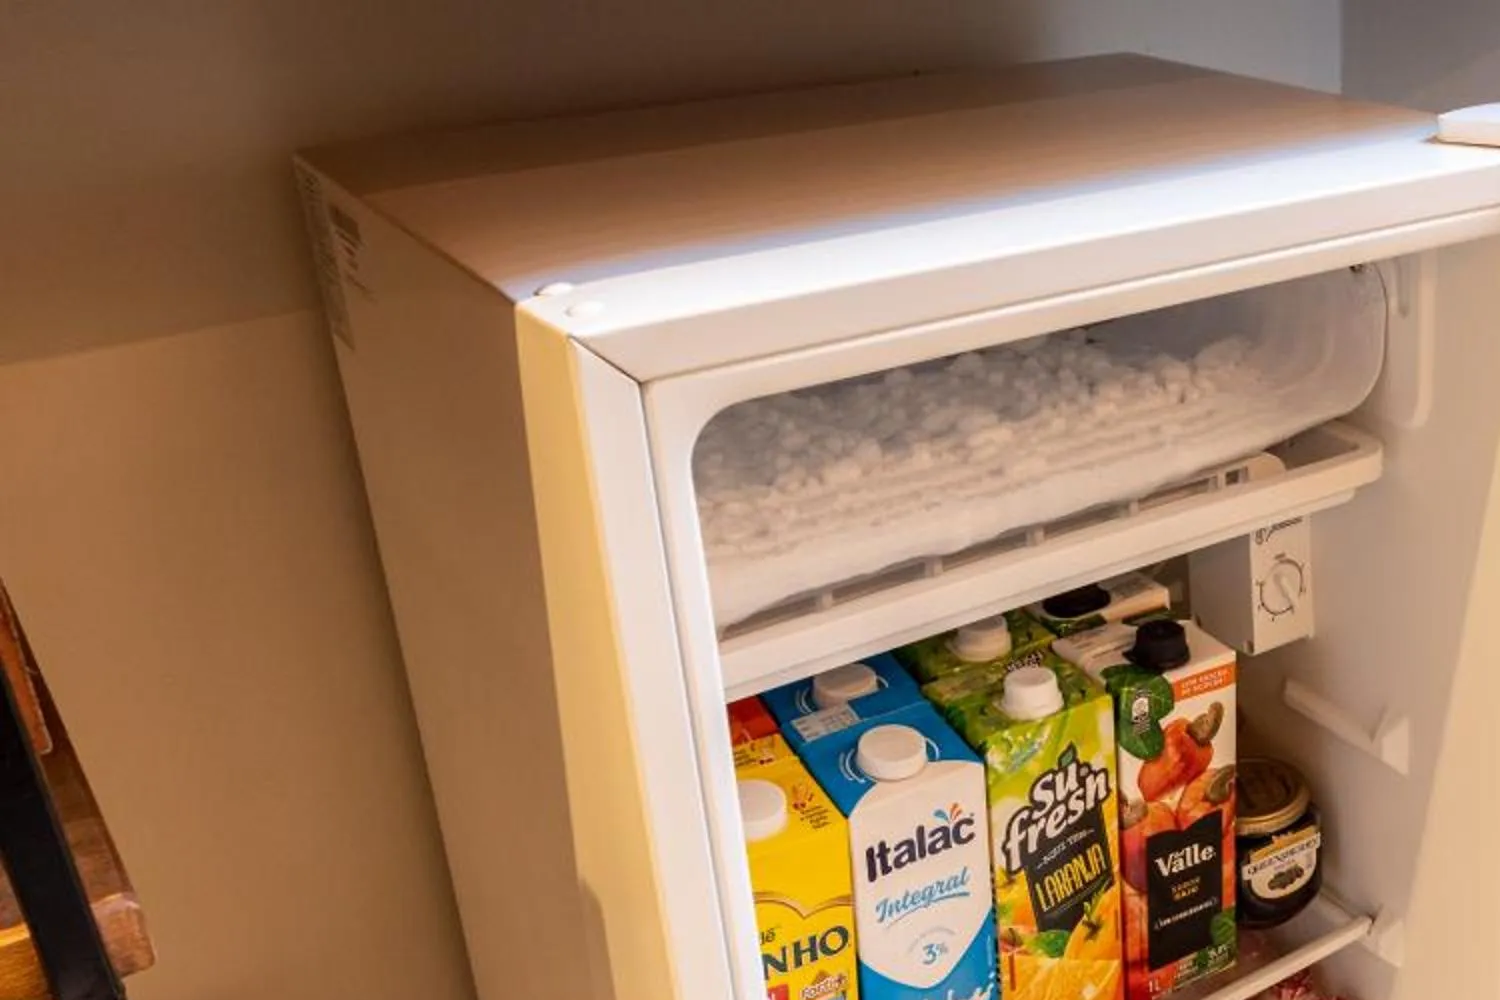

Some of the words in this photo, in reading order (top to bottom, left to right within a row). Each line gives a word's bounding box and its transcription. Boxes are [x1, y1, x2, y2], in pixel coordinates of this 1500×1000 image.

[866, 817, 976, 883] Italac
[1035, 843, 1108, 911] LARANJA
[1154, 845, 1216, 877] Valle
[876, 866, 971, 924] Integral
[763, 925, 849, 981] NHO
